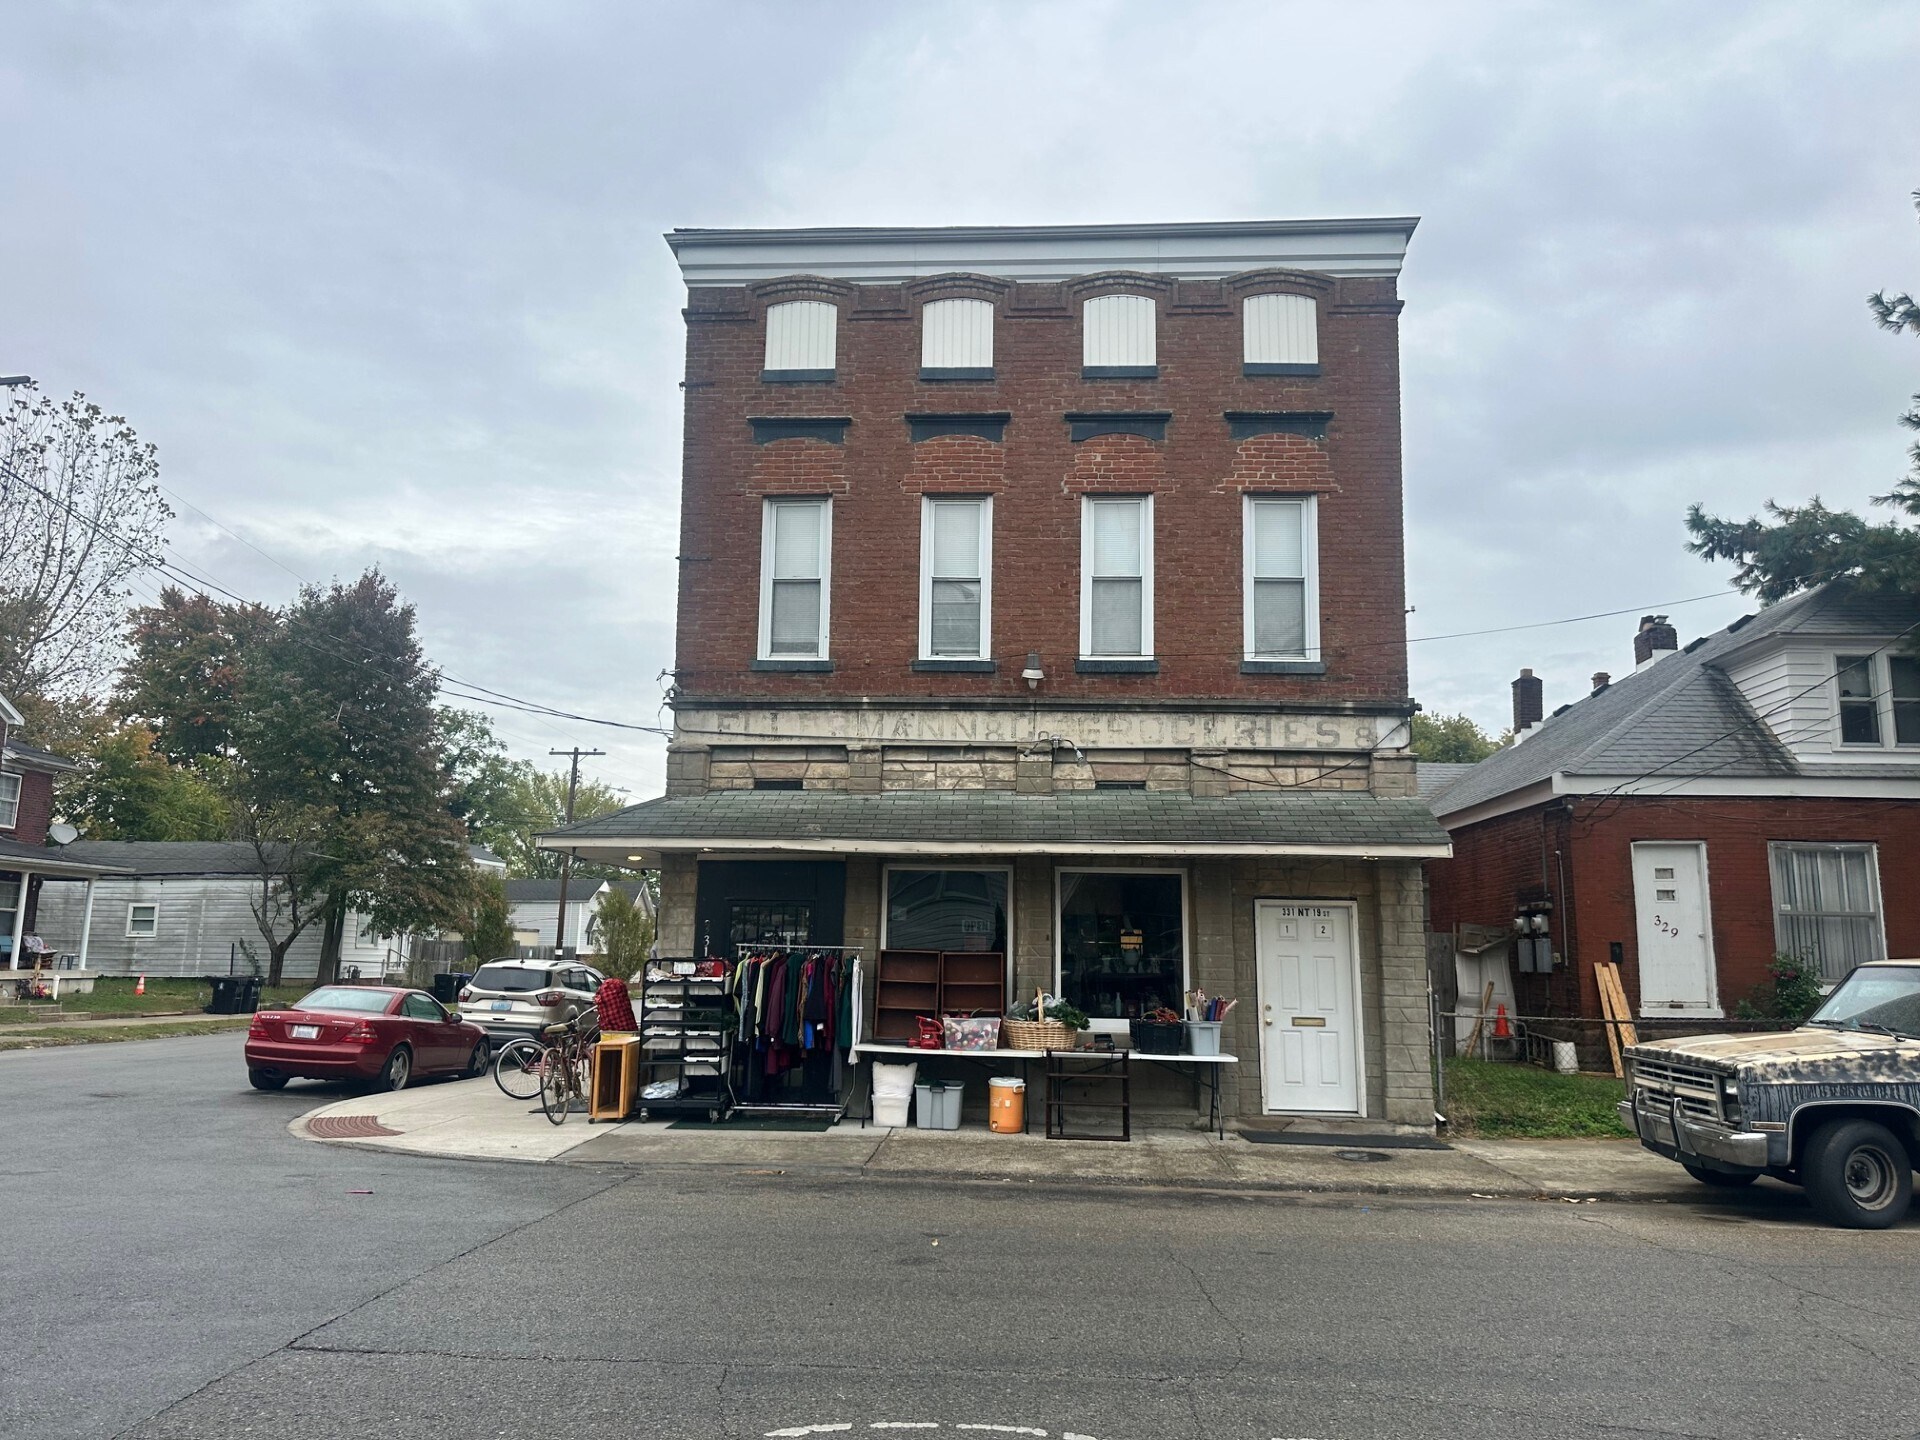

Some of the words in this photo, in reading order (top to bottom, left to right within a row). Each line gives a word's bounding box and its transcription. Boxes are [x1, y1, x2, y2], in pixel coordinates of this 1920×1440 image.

[1282, 907, 1295, 917] 331
[1312, 907, 1321, 917] 19
[964, 920, 990, 932] OPEN
[1320, 925, 1326, 934] 2
[1653, 914, 1679, 938] 329
